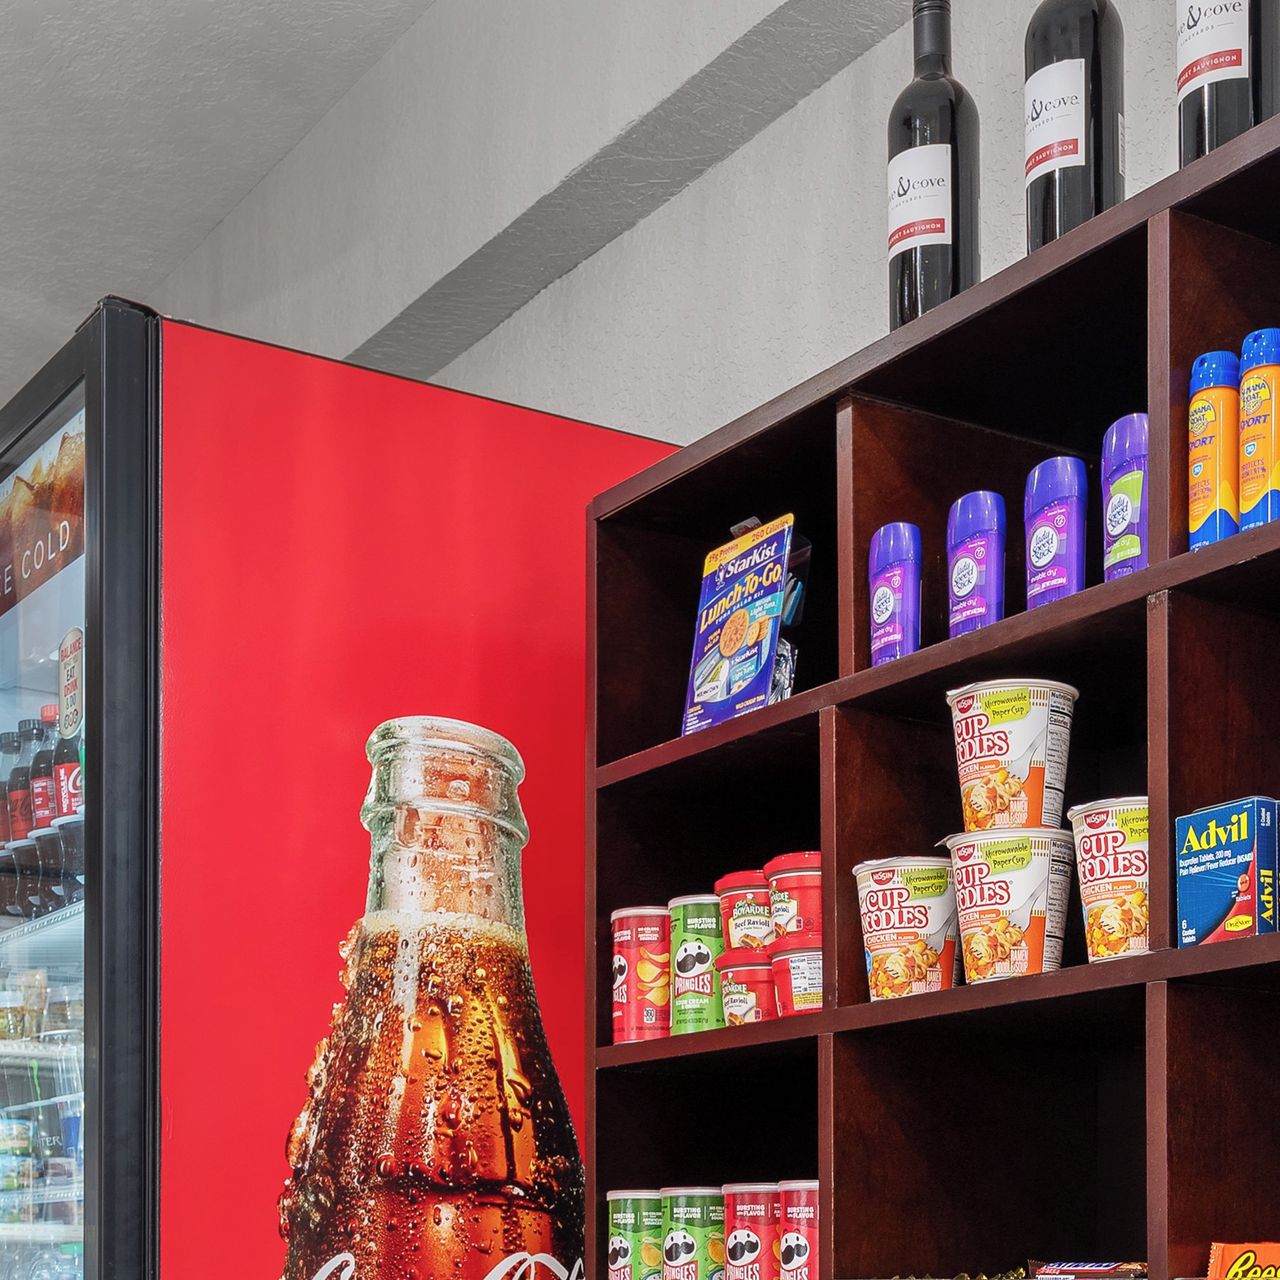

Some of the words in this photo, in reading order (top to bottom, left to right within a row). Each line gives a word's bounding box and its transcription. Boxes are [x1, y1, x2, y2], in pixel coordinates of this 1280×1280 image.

[1204, 1, 1242, 18] cove
[1193, 54, 1236, 74] SAUVIGNON
[1035, 143, 1074, 165] SAUVIGNON
[912, 175, 945, 190] cove
[903, 223, 941, 237] SAUVIGNON
[765, 518, 790, 536] Calories
[20, 518, 71, 581] COLD
[726, 542, 778, 579] StarKist
[734, 646, 758, 665] StarKist
[66, 665, 75, 682] EAT
[985, 692, 1027, 711] Microwavable
[1086, 814, 1107, 825] NISSIN
[1180, 812, 1248, 854] Advil
[985, 843, 1028, 861] Microwavable
[1079, 831, 1126, 859] CUP
[873, 872, 893, 881] NISSIN
[906, 871, 946, 886] Microwavable
[913, 884, 931, 895] Paper
[931, 882, 943, 893] Cup
[1083, 884, 1113, 896] CHICKEN
[866, 889, 910, 913] CUP
[1261, 870, 1274, 925] Advil
[748, 917, 770, 928] Ravioli
[1182, 919, 1187, 930] 6
[867, 934, 897, 945] CHICKEN
[674, 973, 712, 994] PRINGLES
[736, 1204, 765, 1212] BURSTING
